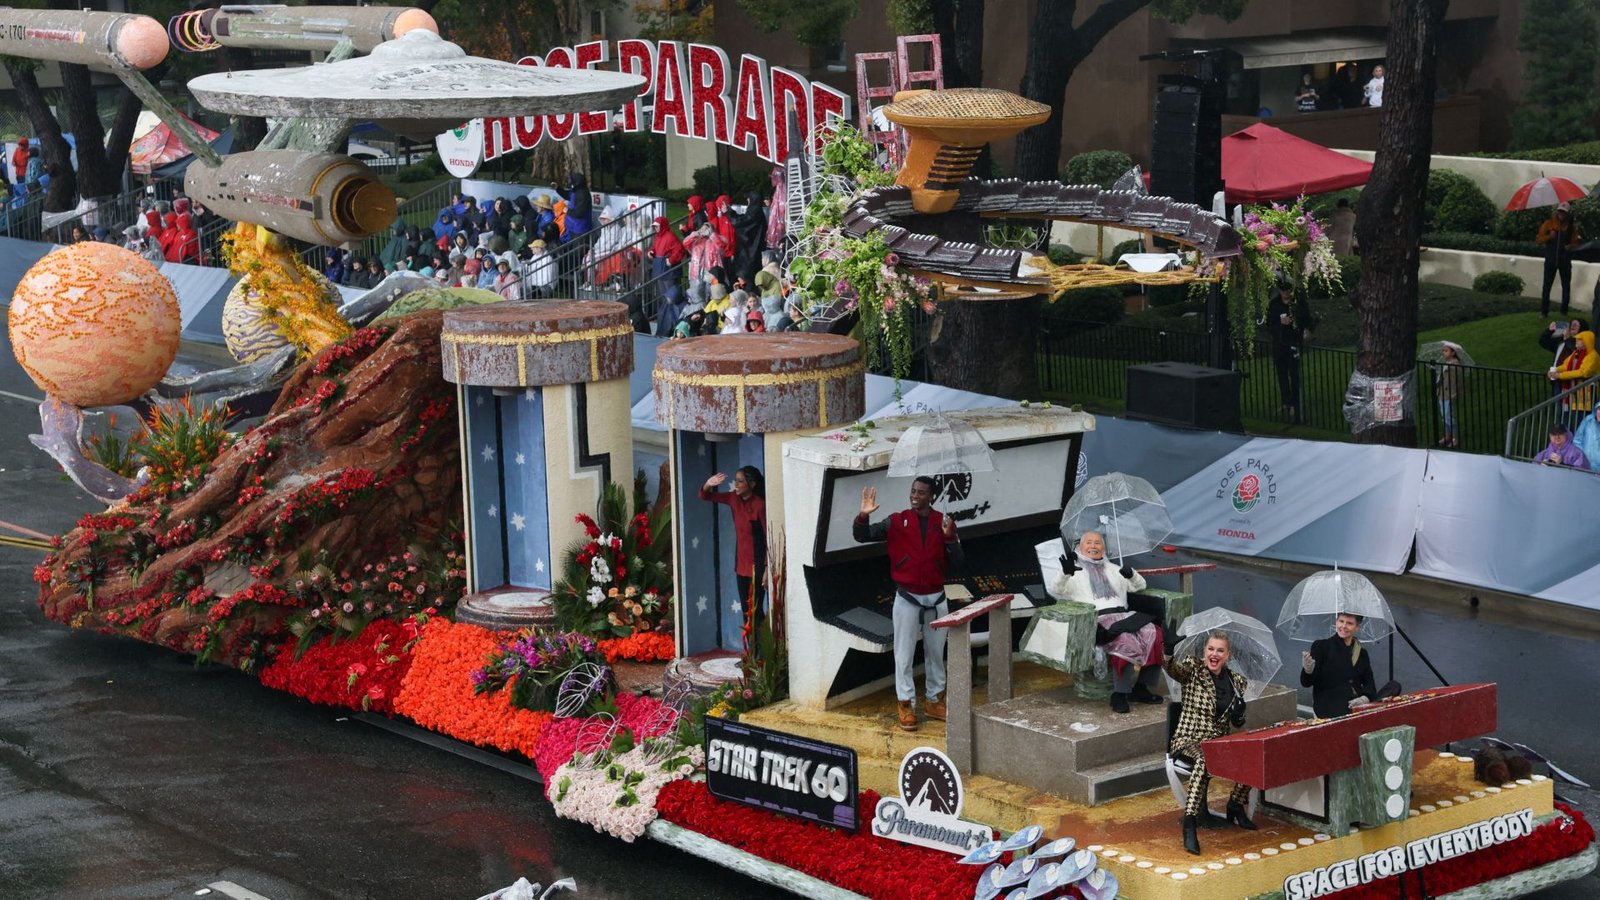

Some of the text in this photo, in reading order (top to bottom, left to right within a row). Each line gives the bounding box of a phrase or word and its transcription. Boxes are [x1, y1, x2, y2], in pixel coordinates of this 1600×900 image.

[617, 39, 848, 166] PARADE
[449, 158, 475, 167] HONDA
[593, 194, 601, 205] 15
[1216, 458, 1277, 504] ROSE PARADE
[1217, 528, 1255, 540] HONDA
[708, 738, 848, 803] STAR TREK 60
[1285, 808, 1534, 900] SPACE FOR EVERYBODY
